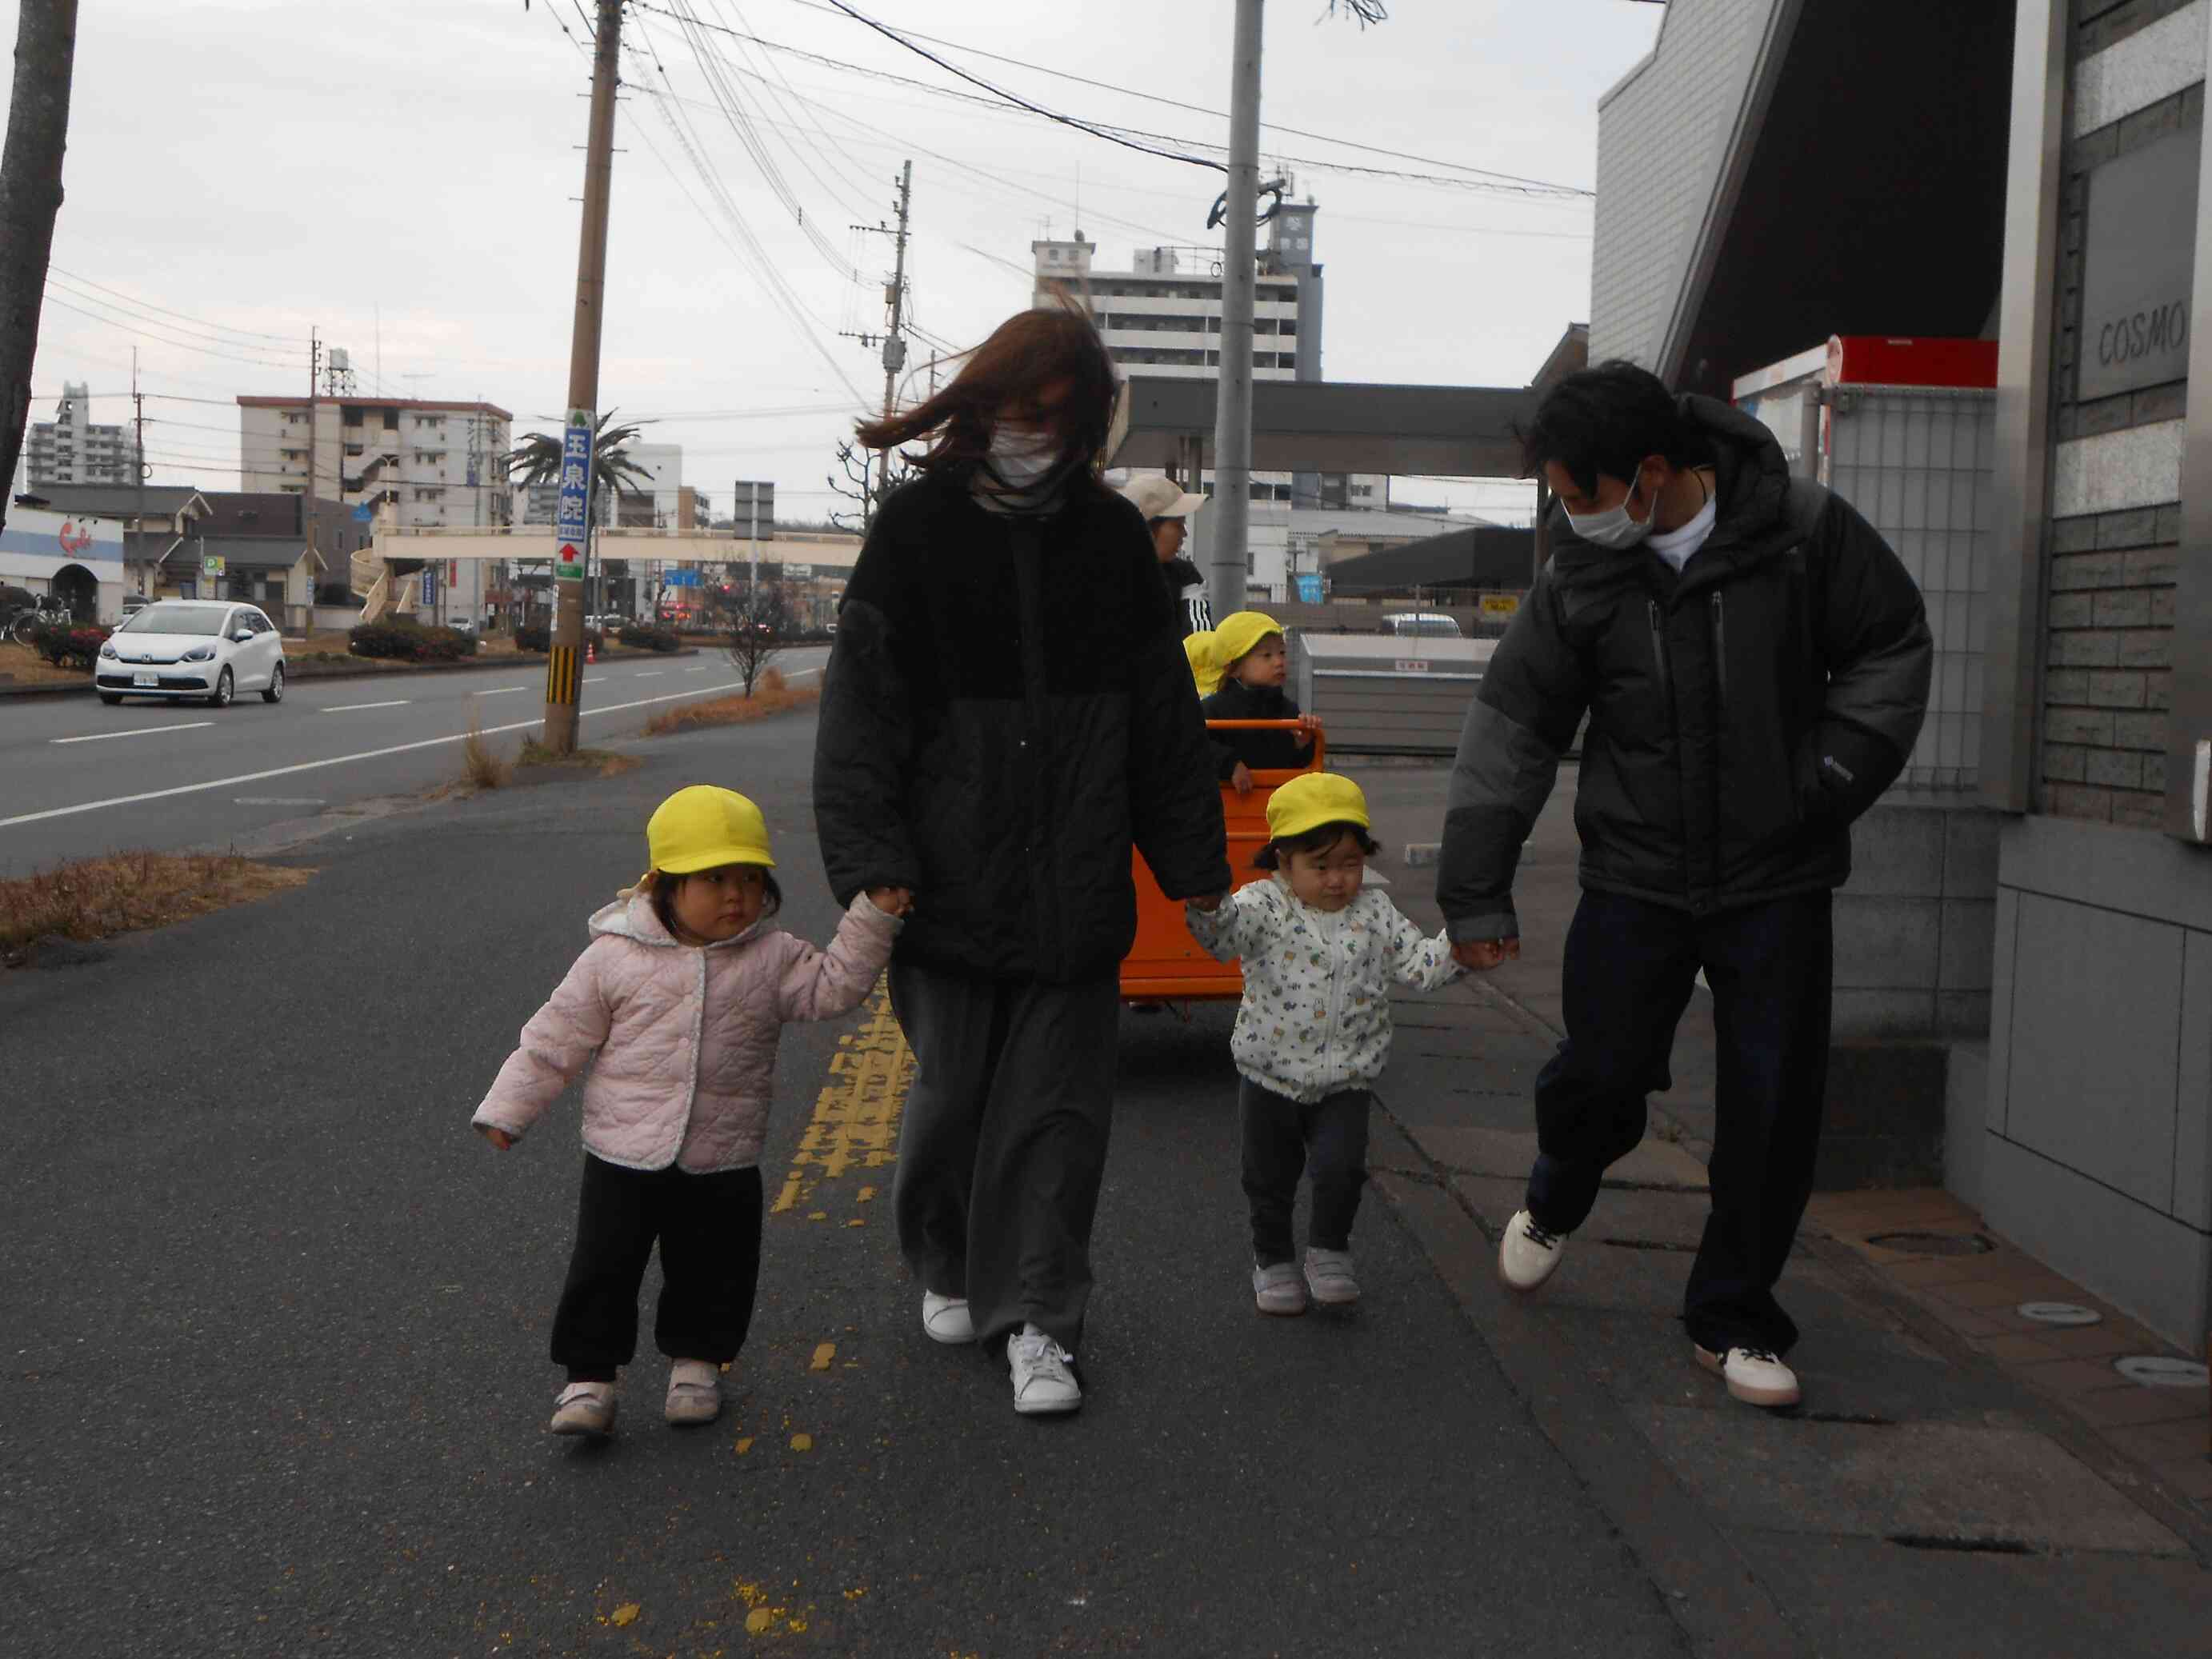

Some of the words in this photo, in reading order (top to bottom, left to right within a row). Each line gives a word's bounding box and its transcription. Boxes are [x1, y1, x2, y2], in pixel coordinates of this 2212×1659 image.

[2099, 300, 2186, 367] COSMO
[561, 434, 588, 520] 玉泉院
